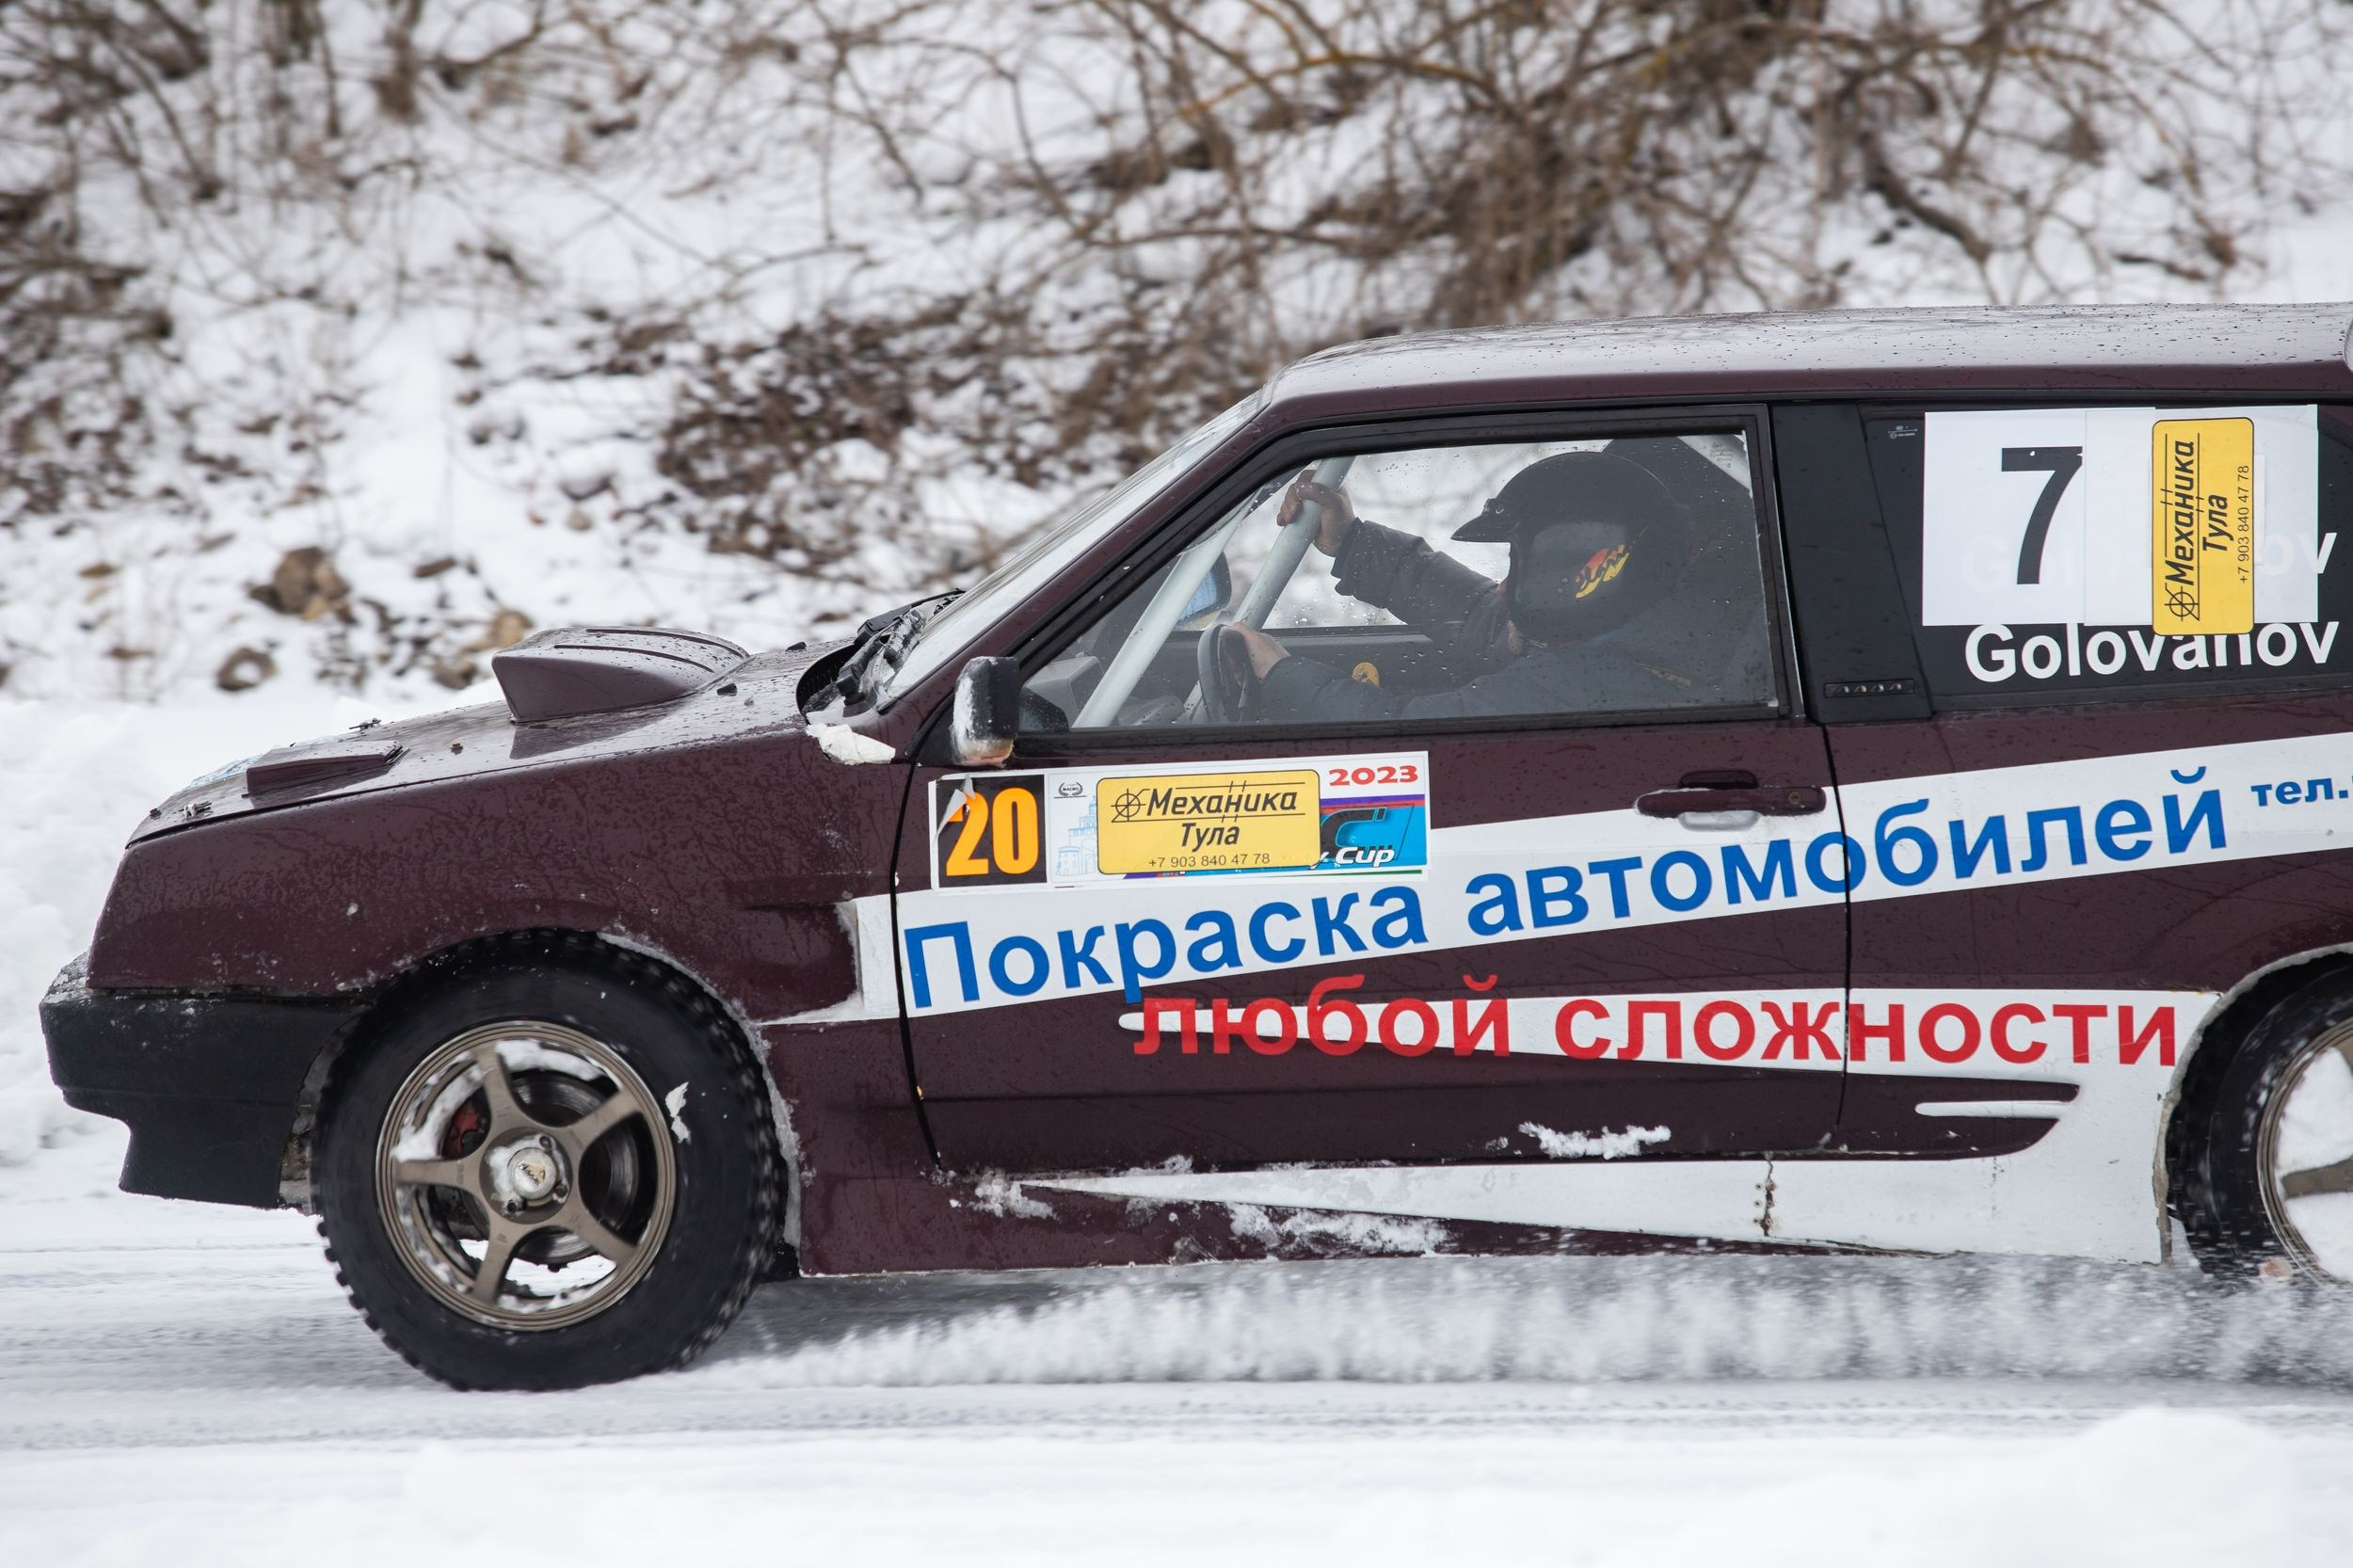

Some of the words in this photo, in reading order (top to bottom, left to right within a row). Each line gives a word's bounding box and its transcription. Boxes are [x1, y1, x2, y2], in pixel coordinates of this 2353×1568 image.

[2237, 465, 2250, 482] 78
[2237, 487, 2249, 504] 47
[2001, 446, 2083, 585] 7
[2165, 440, 2195, 586] Механика
[2201, 494, 2234, 552] Тула
[2237, 507, 2250, 533] 840
[2237, 536, 2250, 562] 903
[2237, 567, 2249, 584] +7
[1965, 621, 2340, 683] Golovanov
[1328, 765, 1418, 786] 2023
[1146, 787, 1298, 816] Механика
[946, 787, 1039, 876] 20
[1181, 822, 1241, 852] Тула
[1148, 857, 1165, 868] +7
[1171, 856, 1196, 867] 903
[1201, 855, 1227, 866] 840
[1231, 854, 1249, 865] 47
[1254, 853, 1271, 864] 78
[1335, 846, 1395, 868] Cup
[904, 855, 1429, 1006] Покраска
[1465, 766, 2228, 937] автомобилей
[2250, 778, 2349, 807] тел.
[1133, 974, 1511, 1058] любой
[1555, 998, 2176, 1066] сложности
